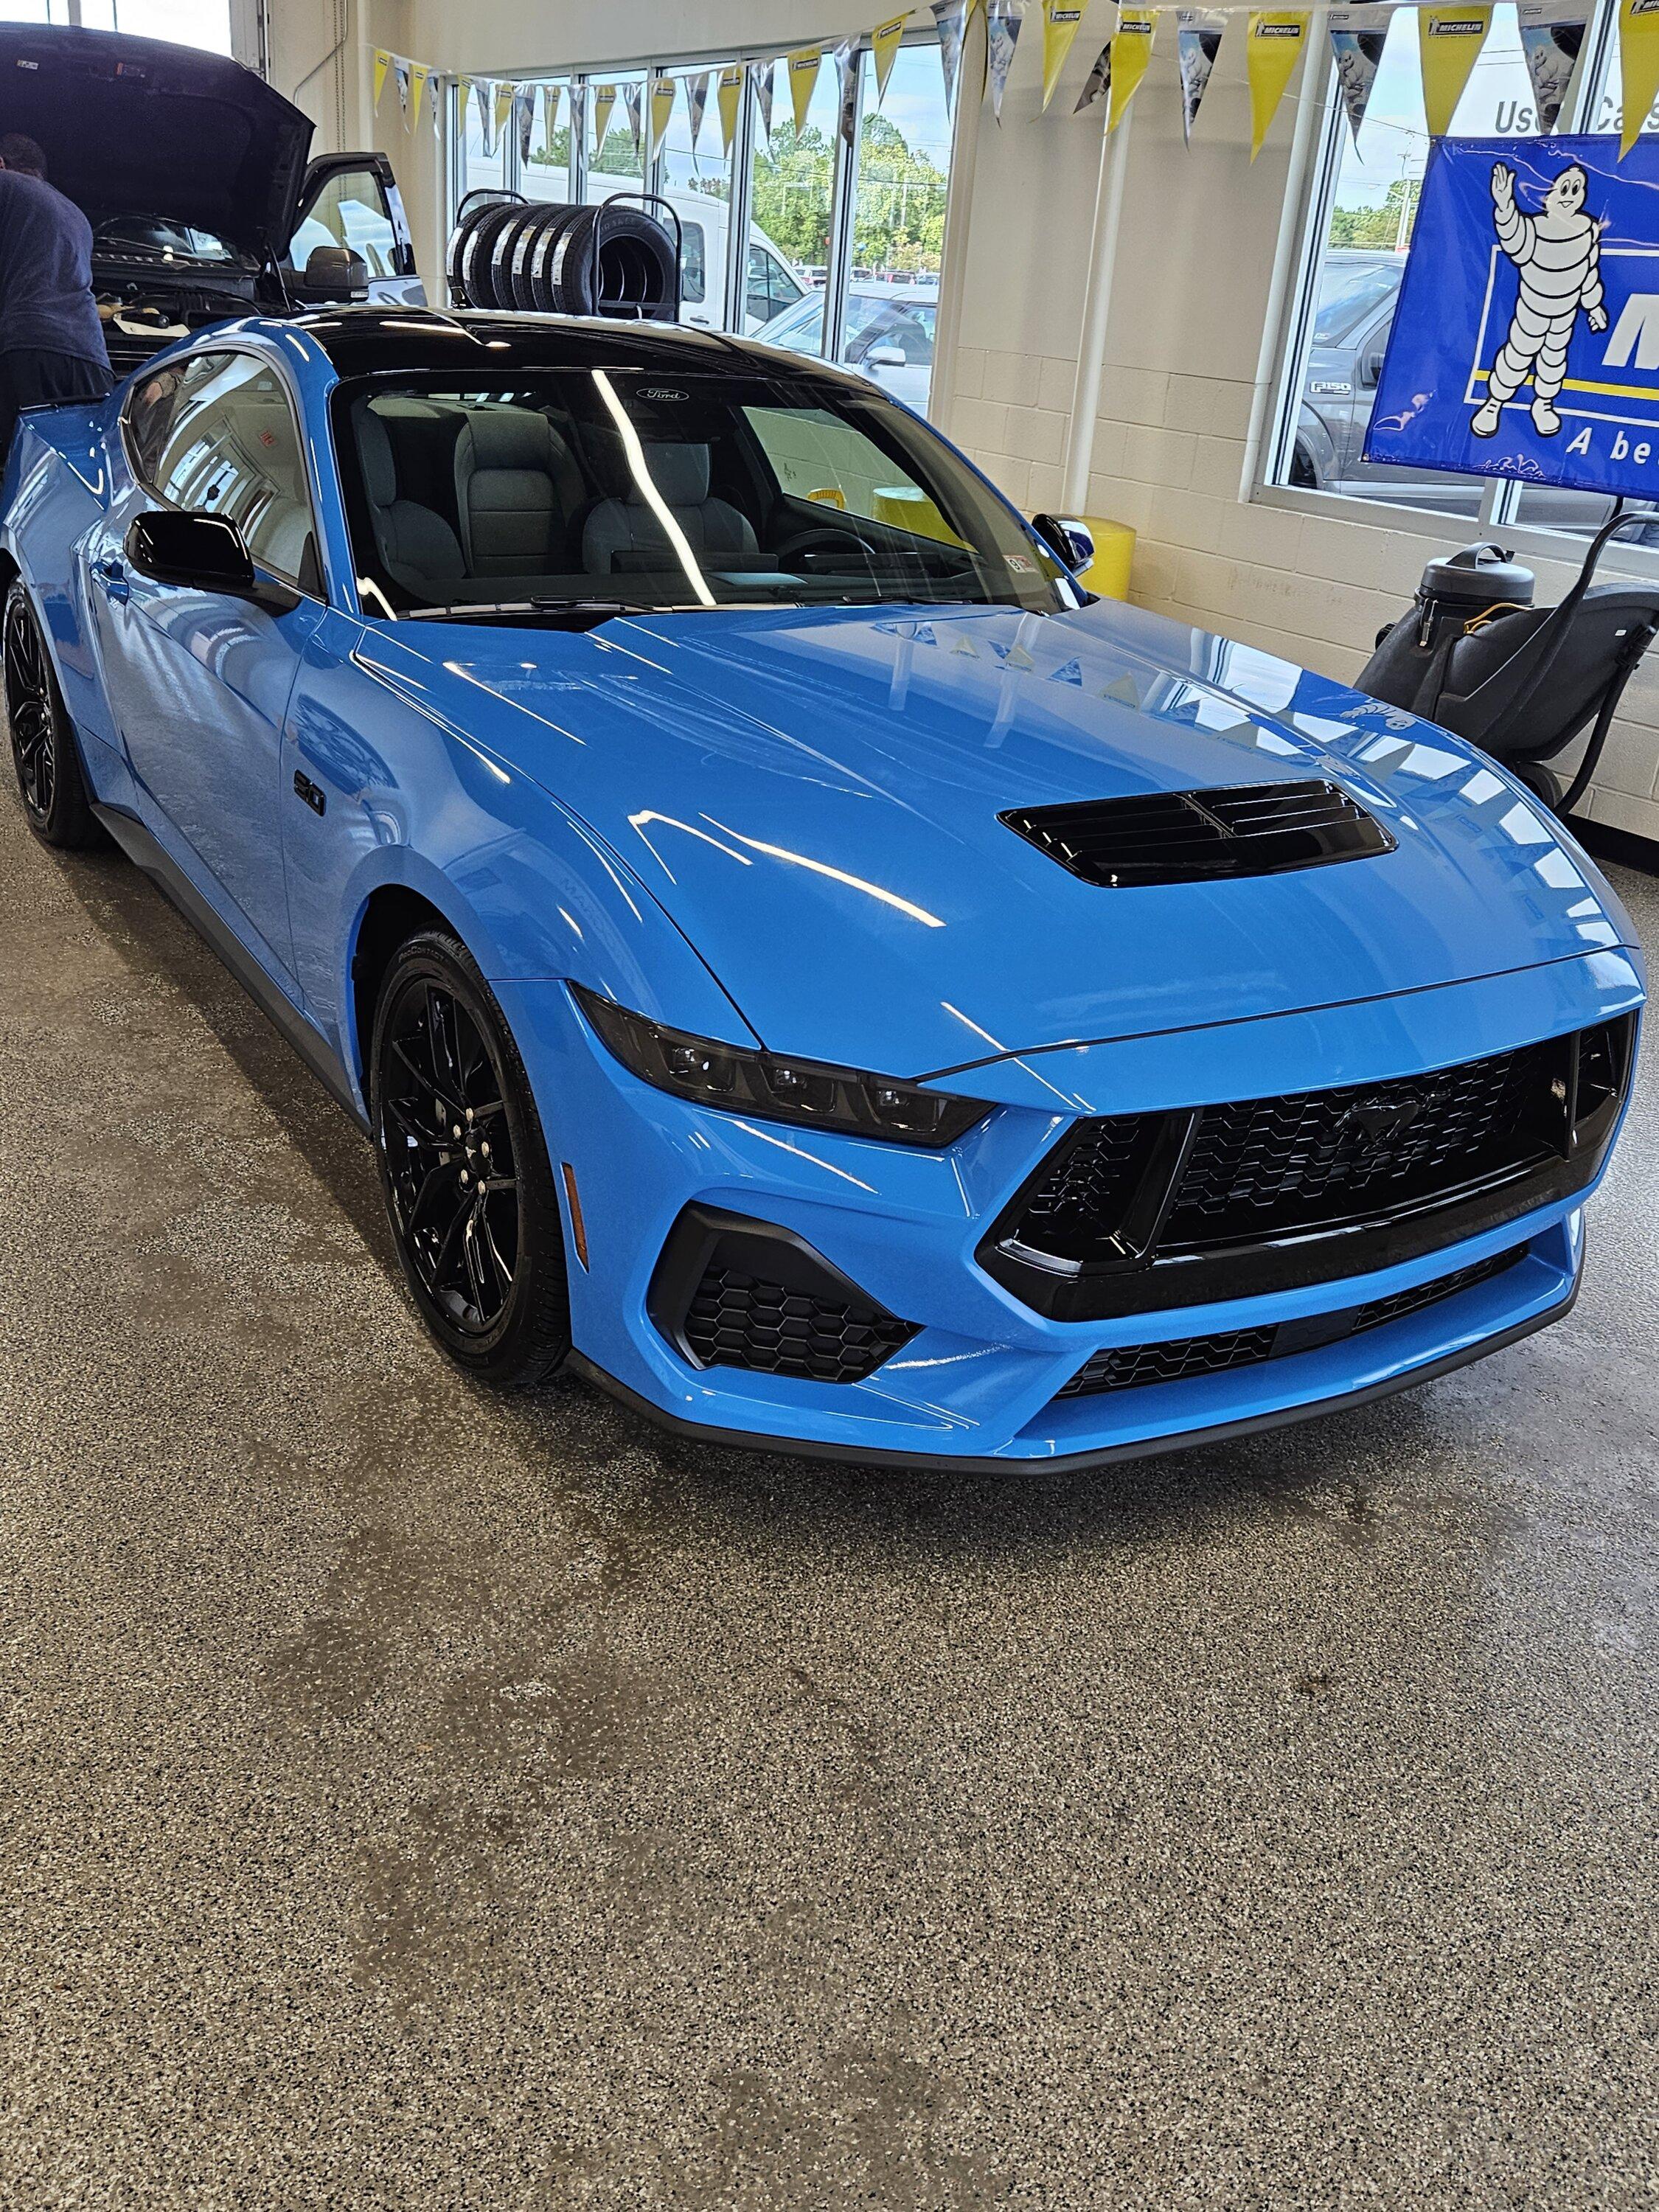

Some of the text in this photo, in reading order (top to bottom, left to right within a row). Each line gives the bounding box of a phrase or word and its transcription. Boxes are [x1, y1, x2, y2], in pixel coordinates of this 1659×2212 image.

[1439, 23, 1482, 32] MICHELIN
[647, 390, 681, 399] Ford
[1566, 427, 1659, 466] A be
